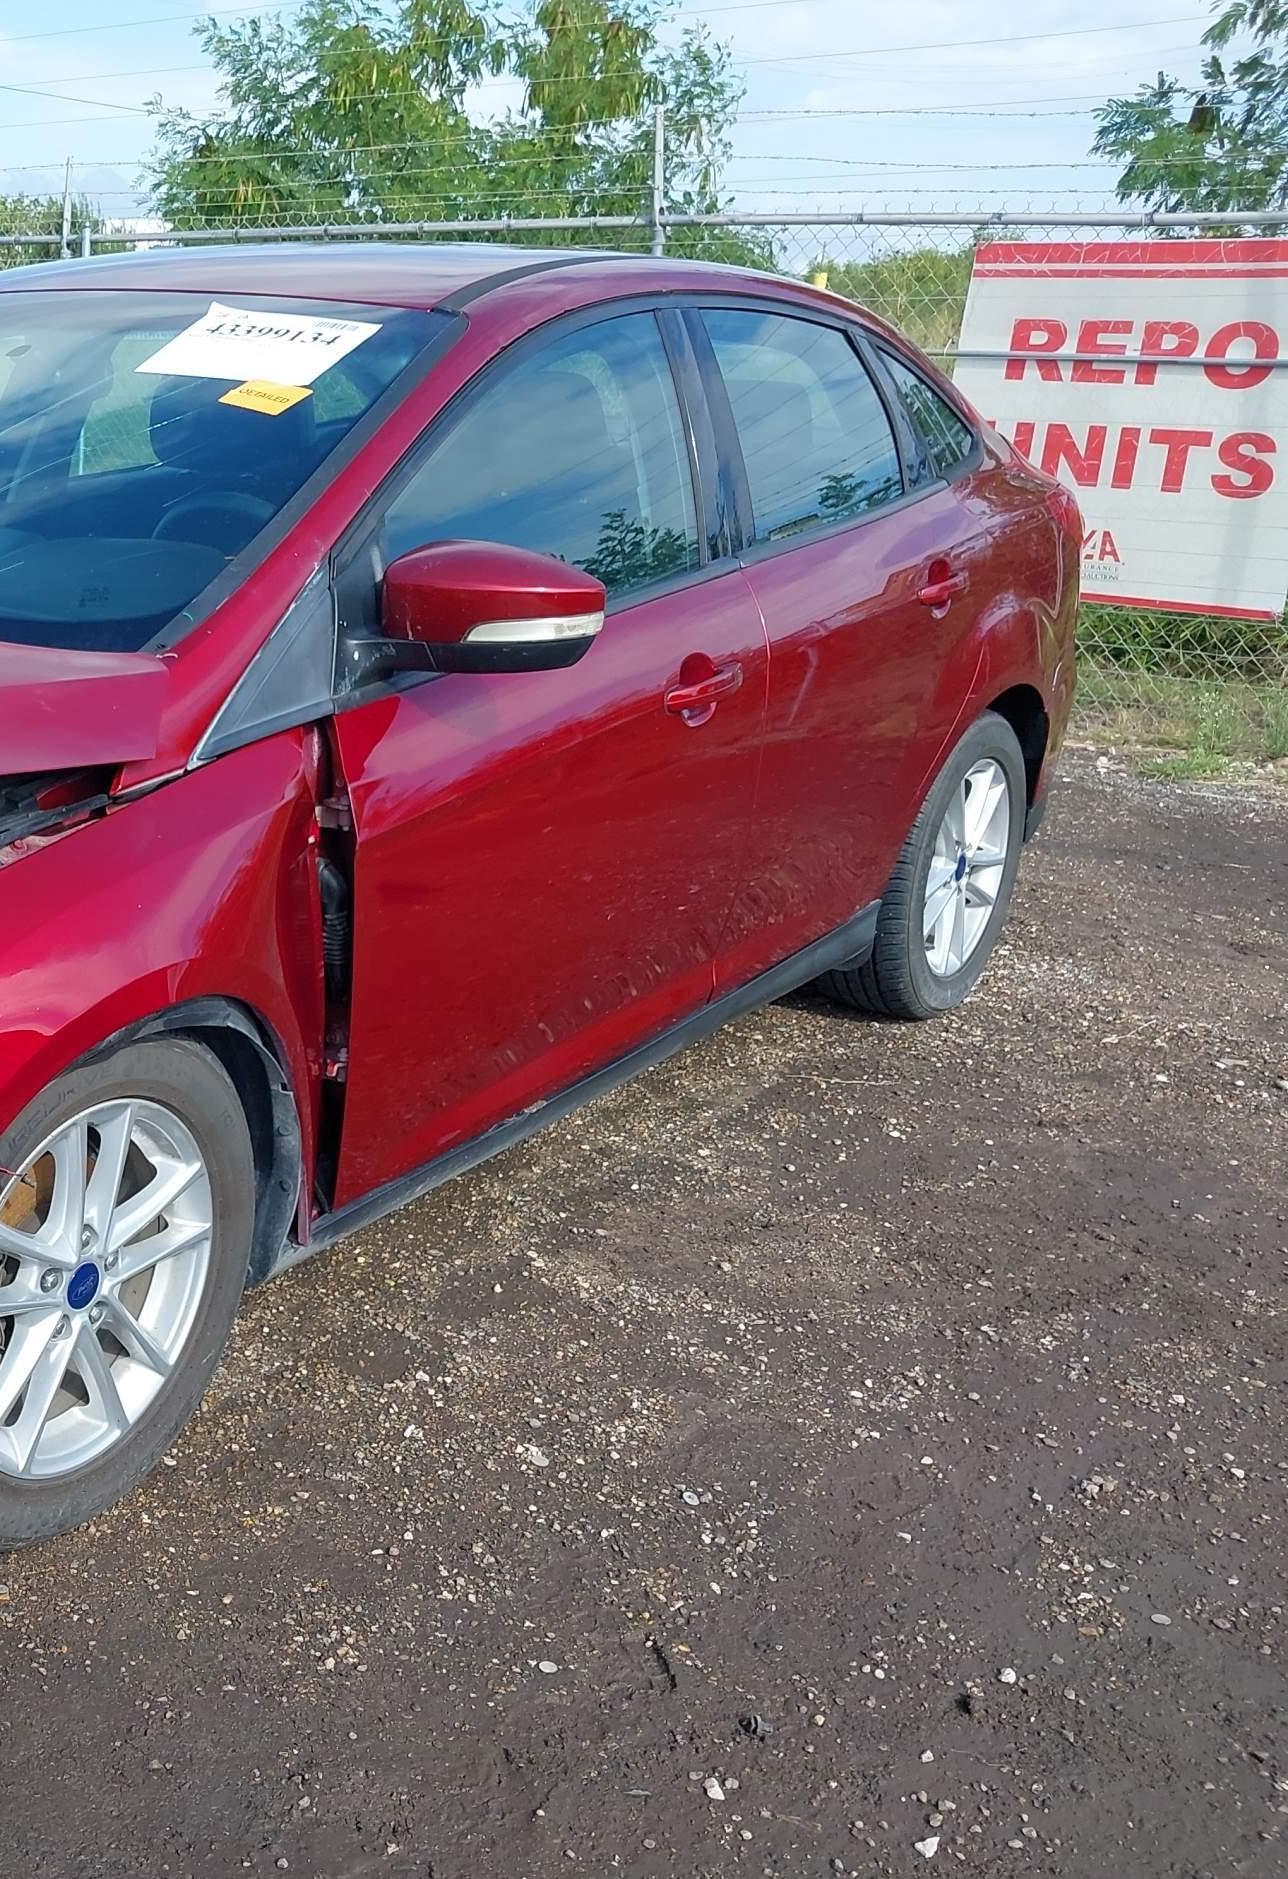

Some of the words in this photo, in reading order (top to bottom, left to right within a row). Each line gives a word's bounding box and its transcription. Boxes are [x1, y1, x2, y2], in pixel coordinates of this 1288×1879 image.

[205, 322, 342, 346] 43399134
[1004, 318, 1280, 390] REPO
[238, 387, 291, 405] DETAILED
